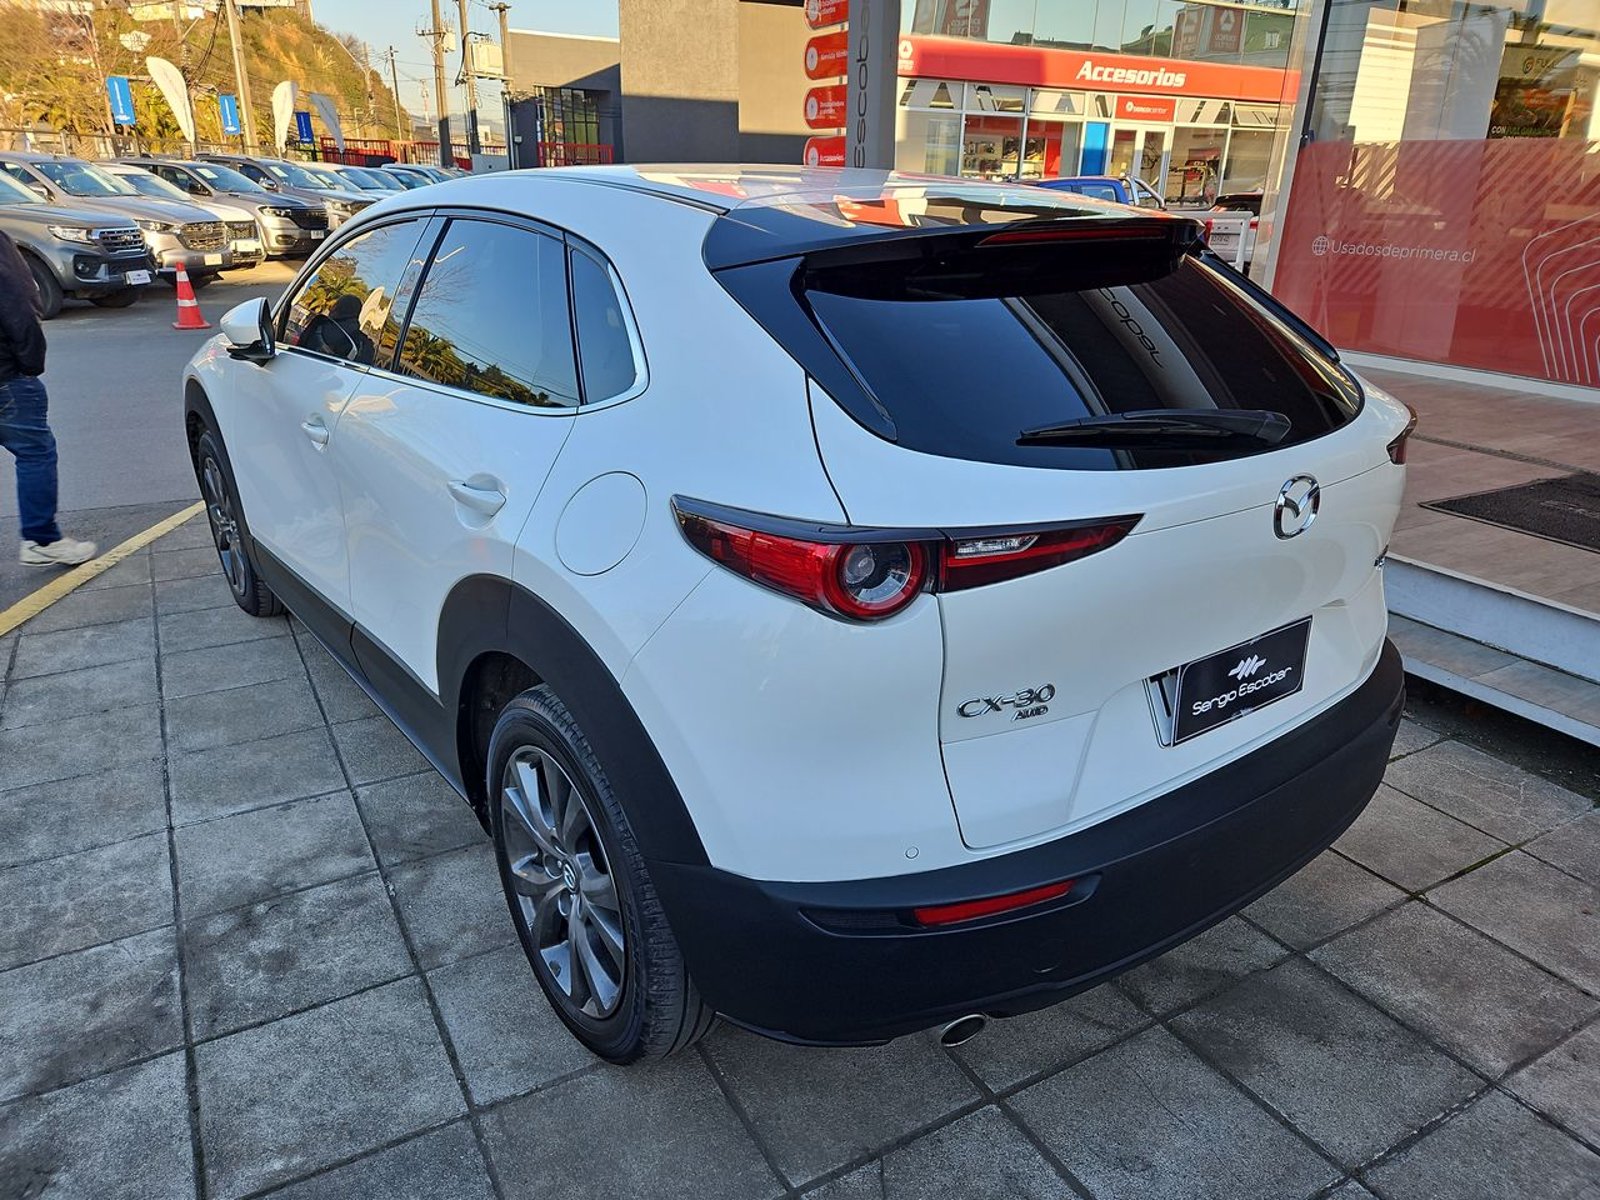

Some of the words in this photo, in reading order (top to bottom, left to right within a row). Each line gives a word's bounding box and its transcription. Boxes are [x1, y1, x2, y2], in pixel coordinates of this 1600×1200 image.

[1076, 60, 1187, 88] Accesorios
[1331, 240, 1477, 263] Usadosdeprimera.cl
[957, 684, 1056, 718] CX-30
[1192, 690, 1237, 716] Sergo
[1238, 666, 1292, 697] Escobar
[1010, 704, 1049, 721] AWD
